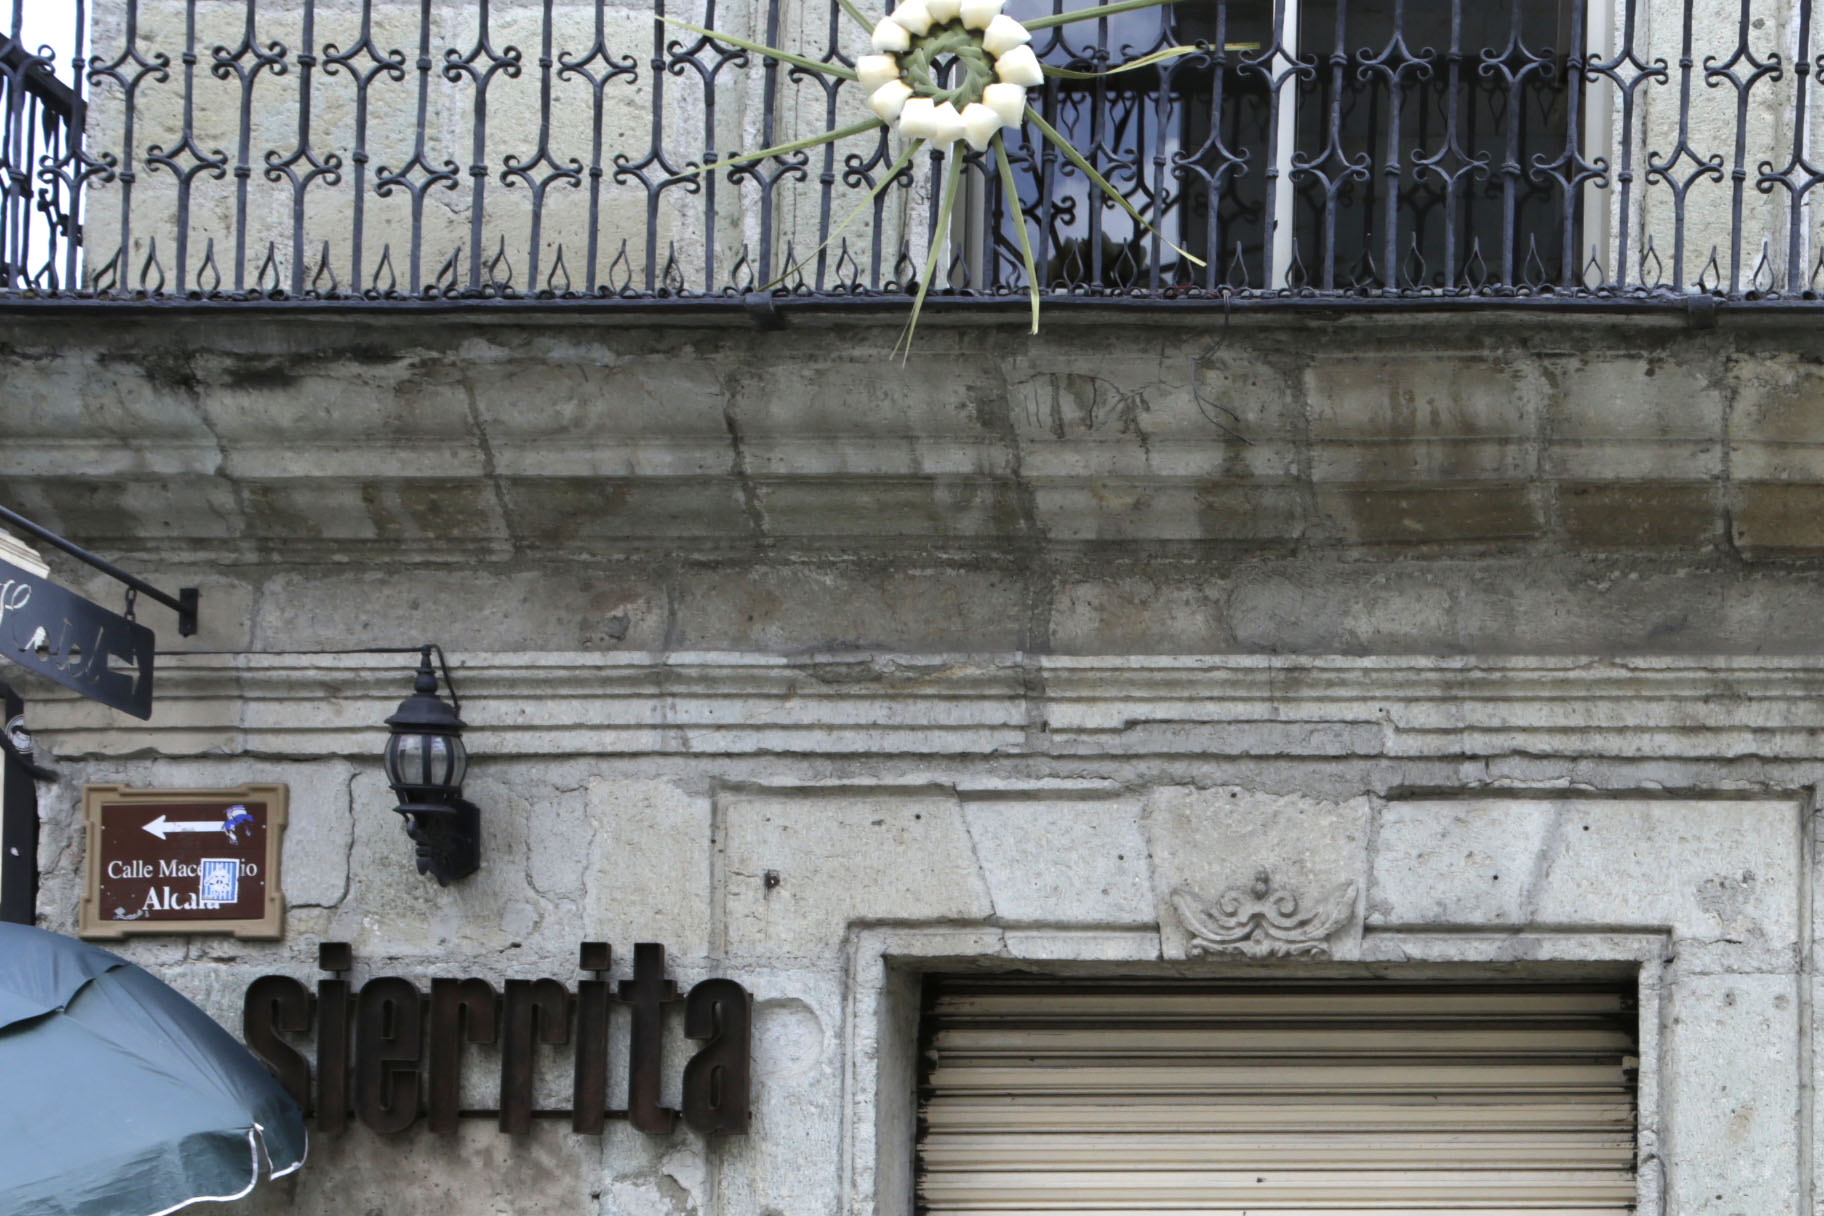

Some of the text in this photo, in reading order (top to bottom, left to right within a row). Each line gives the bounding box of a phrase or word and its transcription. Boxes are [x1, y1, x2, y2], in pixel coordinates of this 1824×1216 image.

[108, 859, 258, 879] Calle Macio
[243, 942, 752, 1136] sierrita
